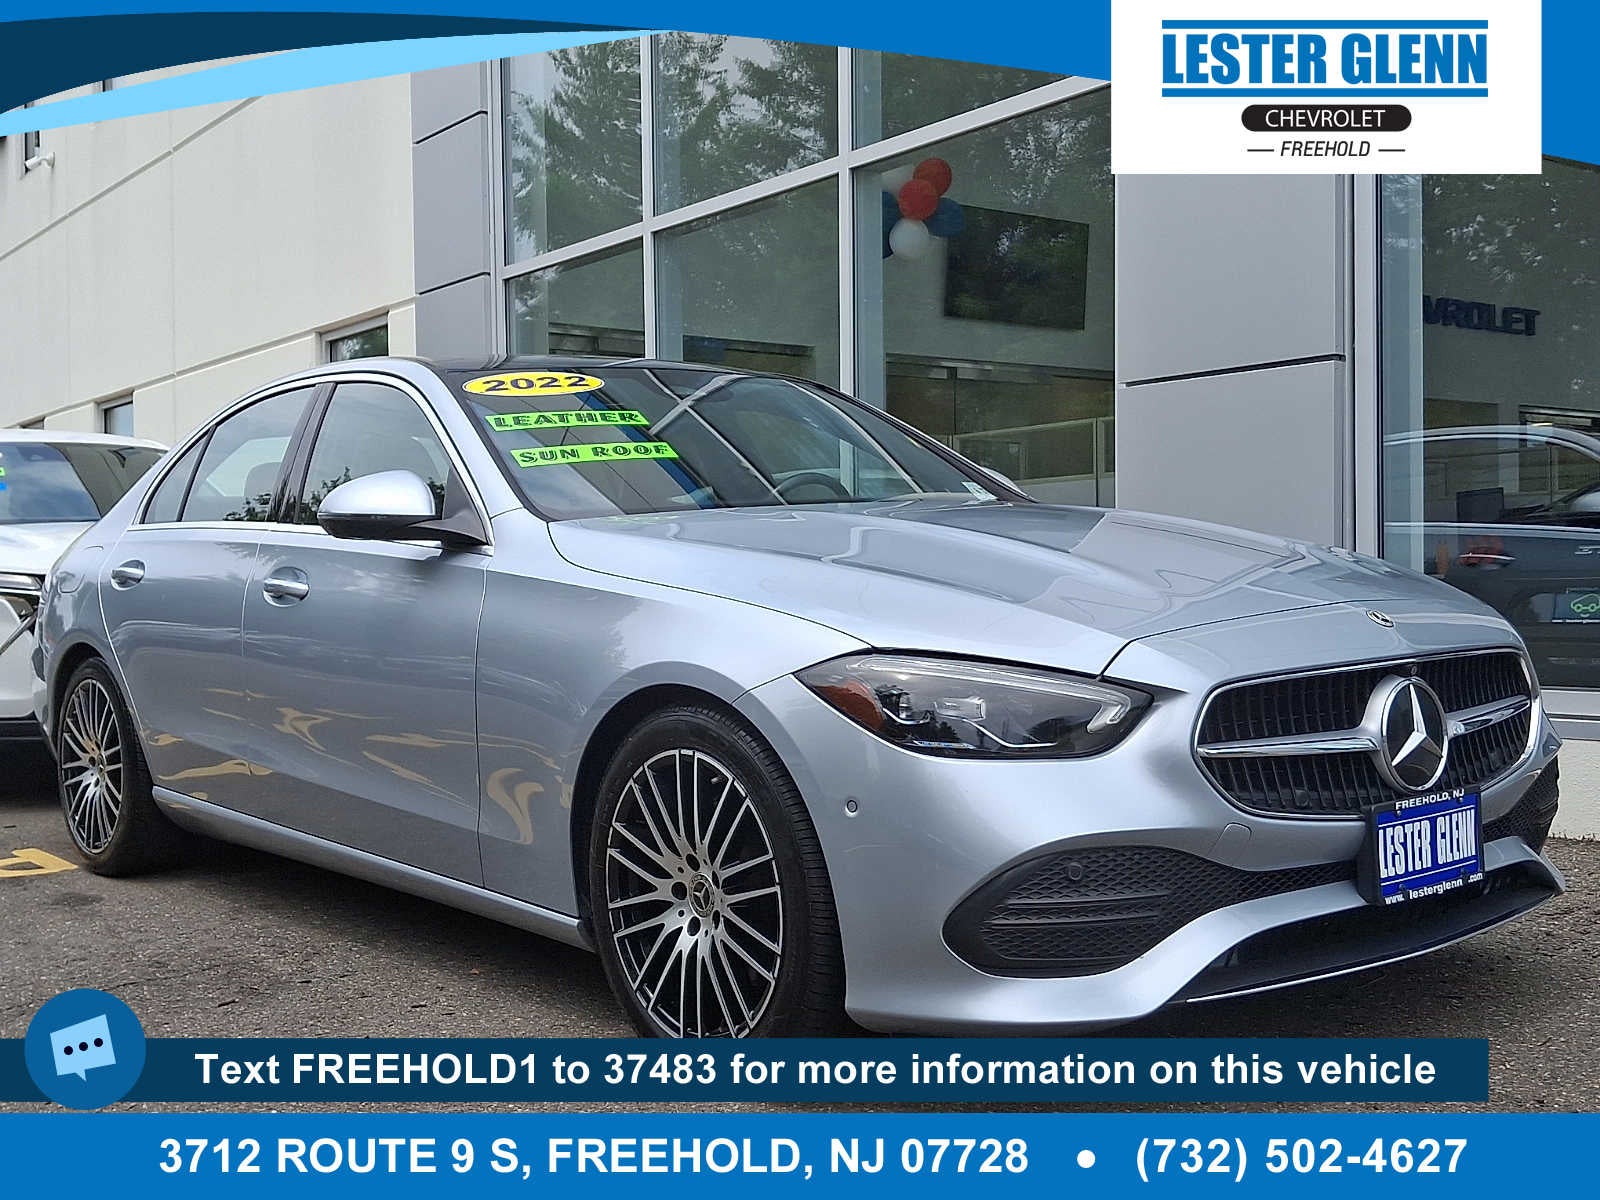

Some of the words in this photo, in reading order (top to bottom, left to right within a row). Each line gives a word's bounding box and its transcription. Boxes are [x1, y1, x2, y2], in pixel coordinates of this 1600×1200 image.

[481, 376, 589, 392] 2022
[494, 411, 641, 428] LEATHER
[519, 448, 580, 464] SUN
[591, 441, 669, 458] ROOF
[1395, 791, 1451, 810] FREEHOLD,
[1453, 788, 1465, 799] NJ
[1378, 819, 1432, 879] LESTER
[1436, 809, 1476, 865] GLENN
[1409, 879, 1463, 900] lesterglenn
